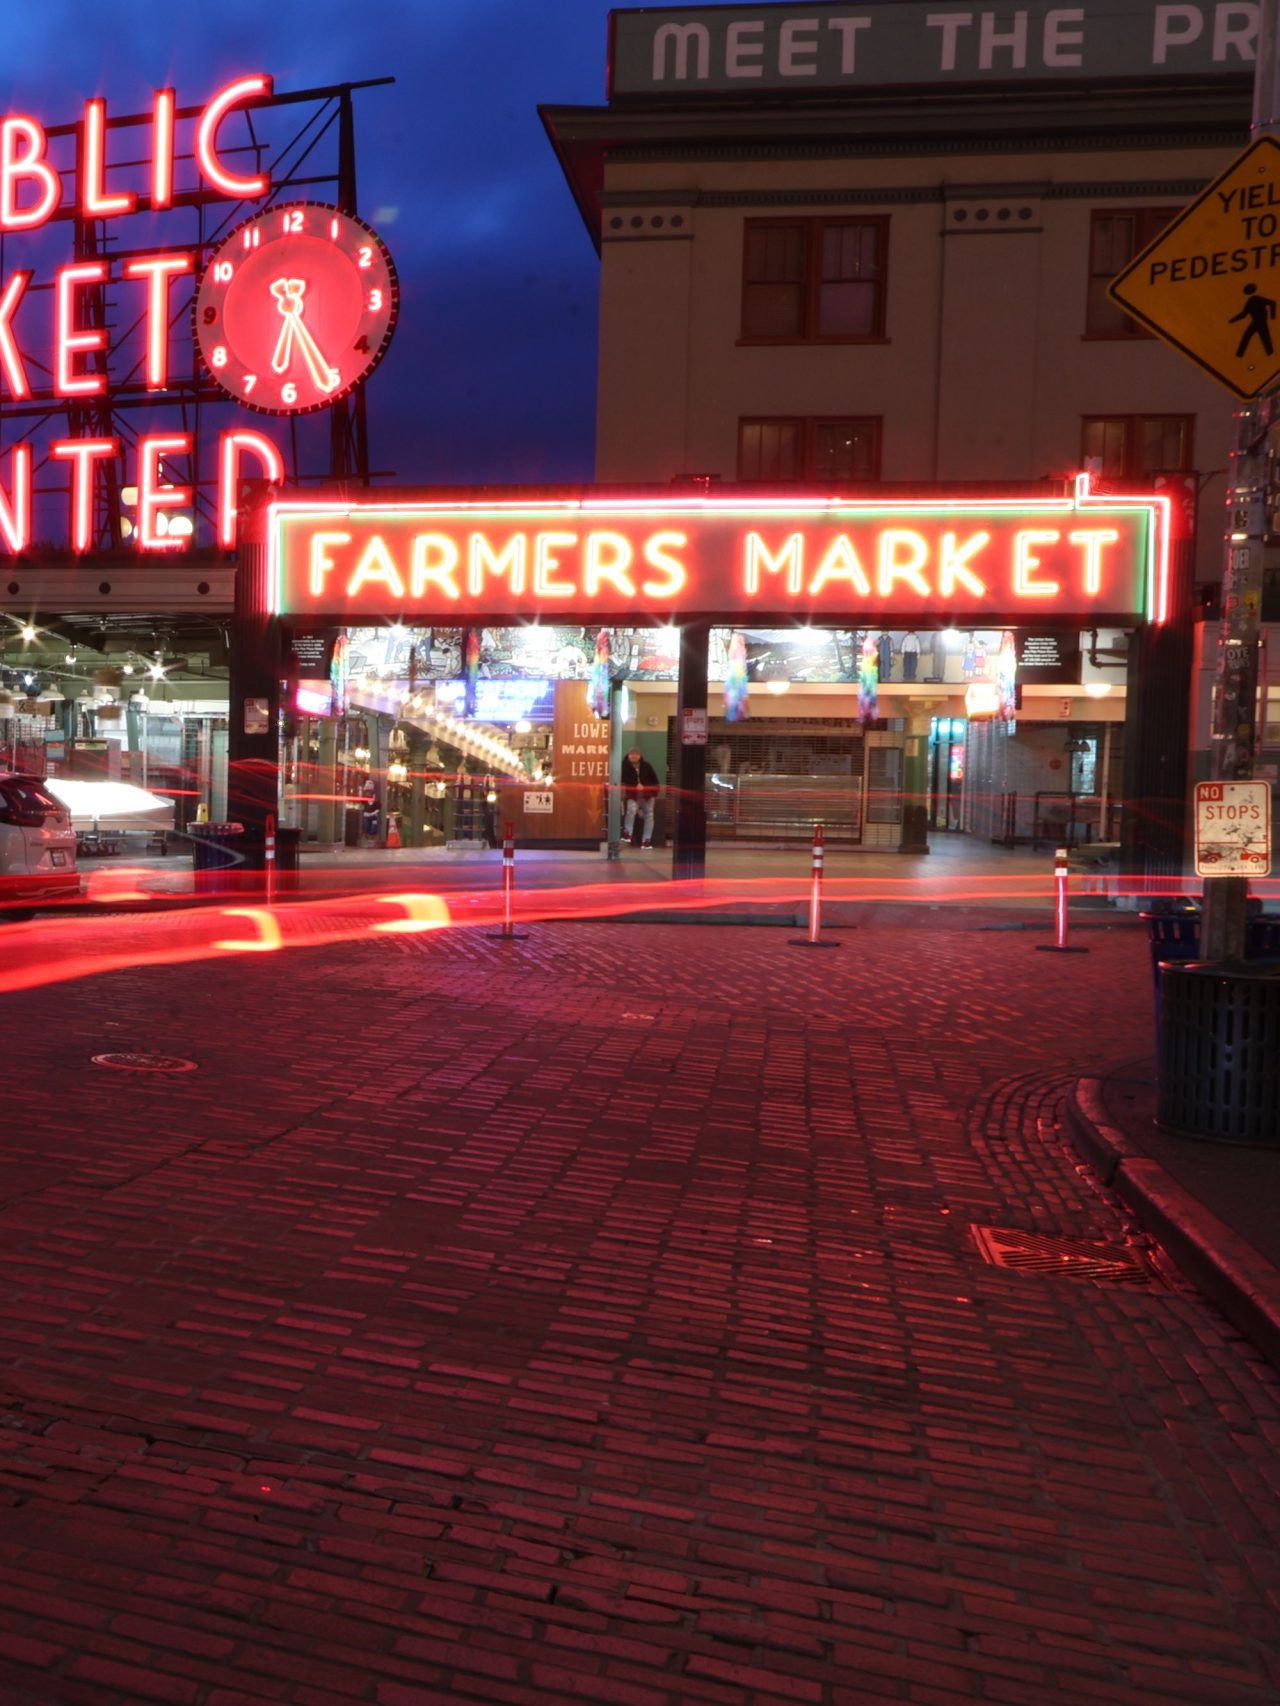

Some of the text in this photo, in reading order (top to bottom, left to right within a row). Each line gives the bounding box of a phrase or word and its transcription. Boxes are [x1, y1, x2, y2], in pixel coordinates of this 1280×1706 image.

[652, 2, 1260, 81] MEET THE PR
[1217, 182, 1280, 213] YIEL
[283, 211, 304, 232] 12
[331, 219, 339, 240] 1
[1242, 213, 1277, 240] TO
[244, 227, 259, 248] 11
[359, 248, 372, 268] 2
[1150, 244, 1280, 285] PEDESTR
[214, 262, 233, 282] 10
[369, 290, 382, 310] 3
[204, 306, 216, 325] 9
[354, 335, 370, 354] 4
[213, 347, 227, 367] 8
[243, 375, 257, 394] 7
[281, 382, 297, 403] 6
[308, 529, 1120, 599] FARMERS MARKET
[574, 723, 608, 738] LOWE
[562, 744, 608, 754] MARK
[572, 761, 610, 776] LEVEL
[1200, 787, 1219, 799] NO
[1205, 805, 1260, 820] STOPS
